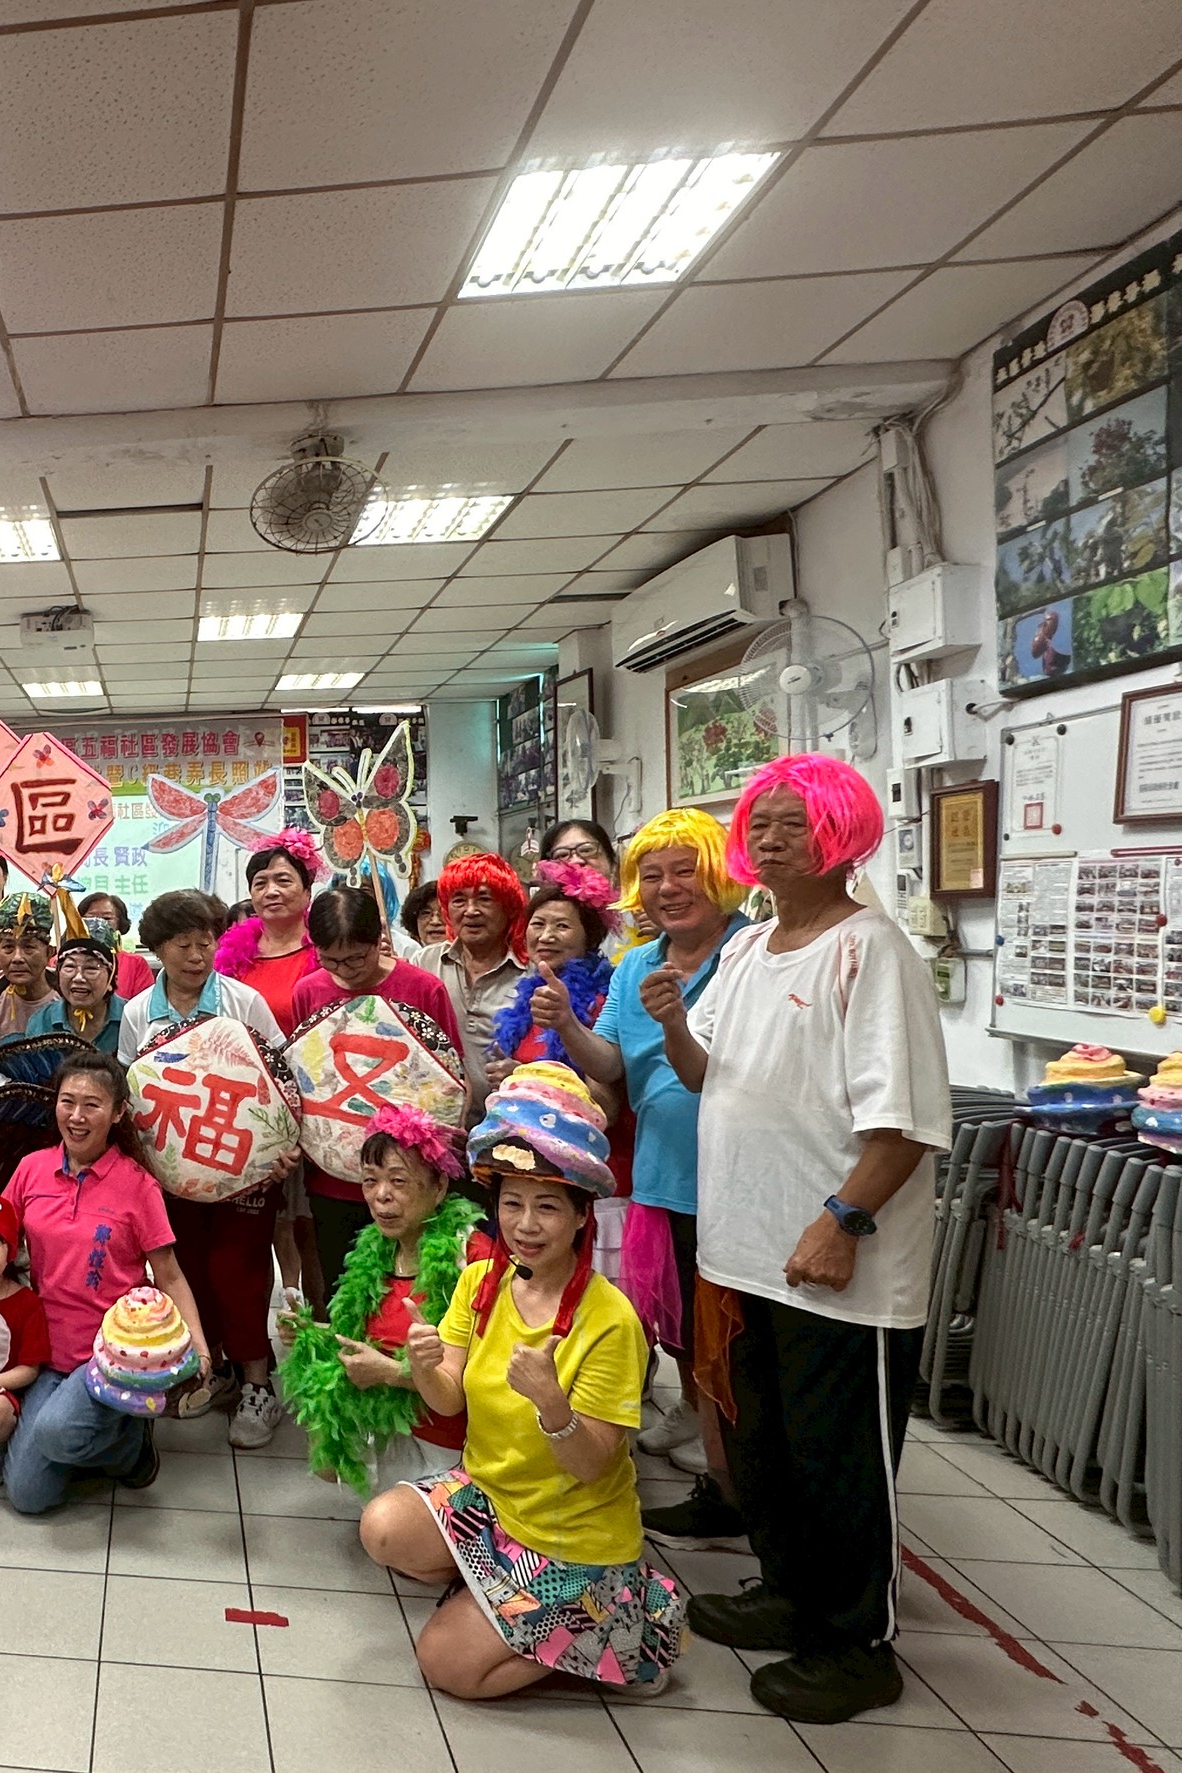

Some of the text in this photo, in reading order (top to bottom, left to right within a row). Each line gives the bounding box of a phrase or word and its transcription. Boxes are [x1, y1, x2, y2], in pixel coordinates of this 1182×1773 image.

[11, 778, 86, 854] 區
[114, 874, 149, 895] 主任
[133, 1066, 257, 1176] 福
